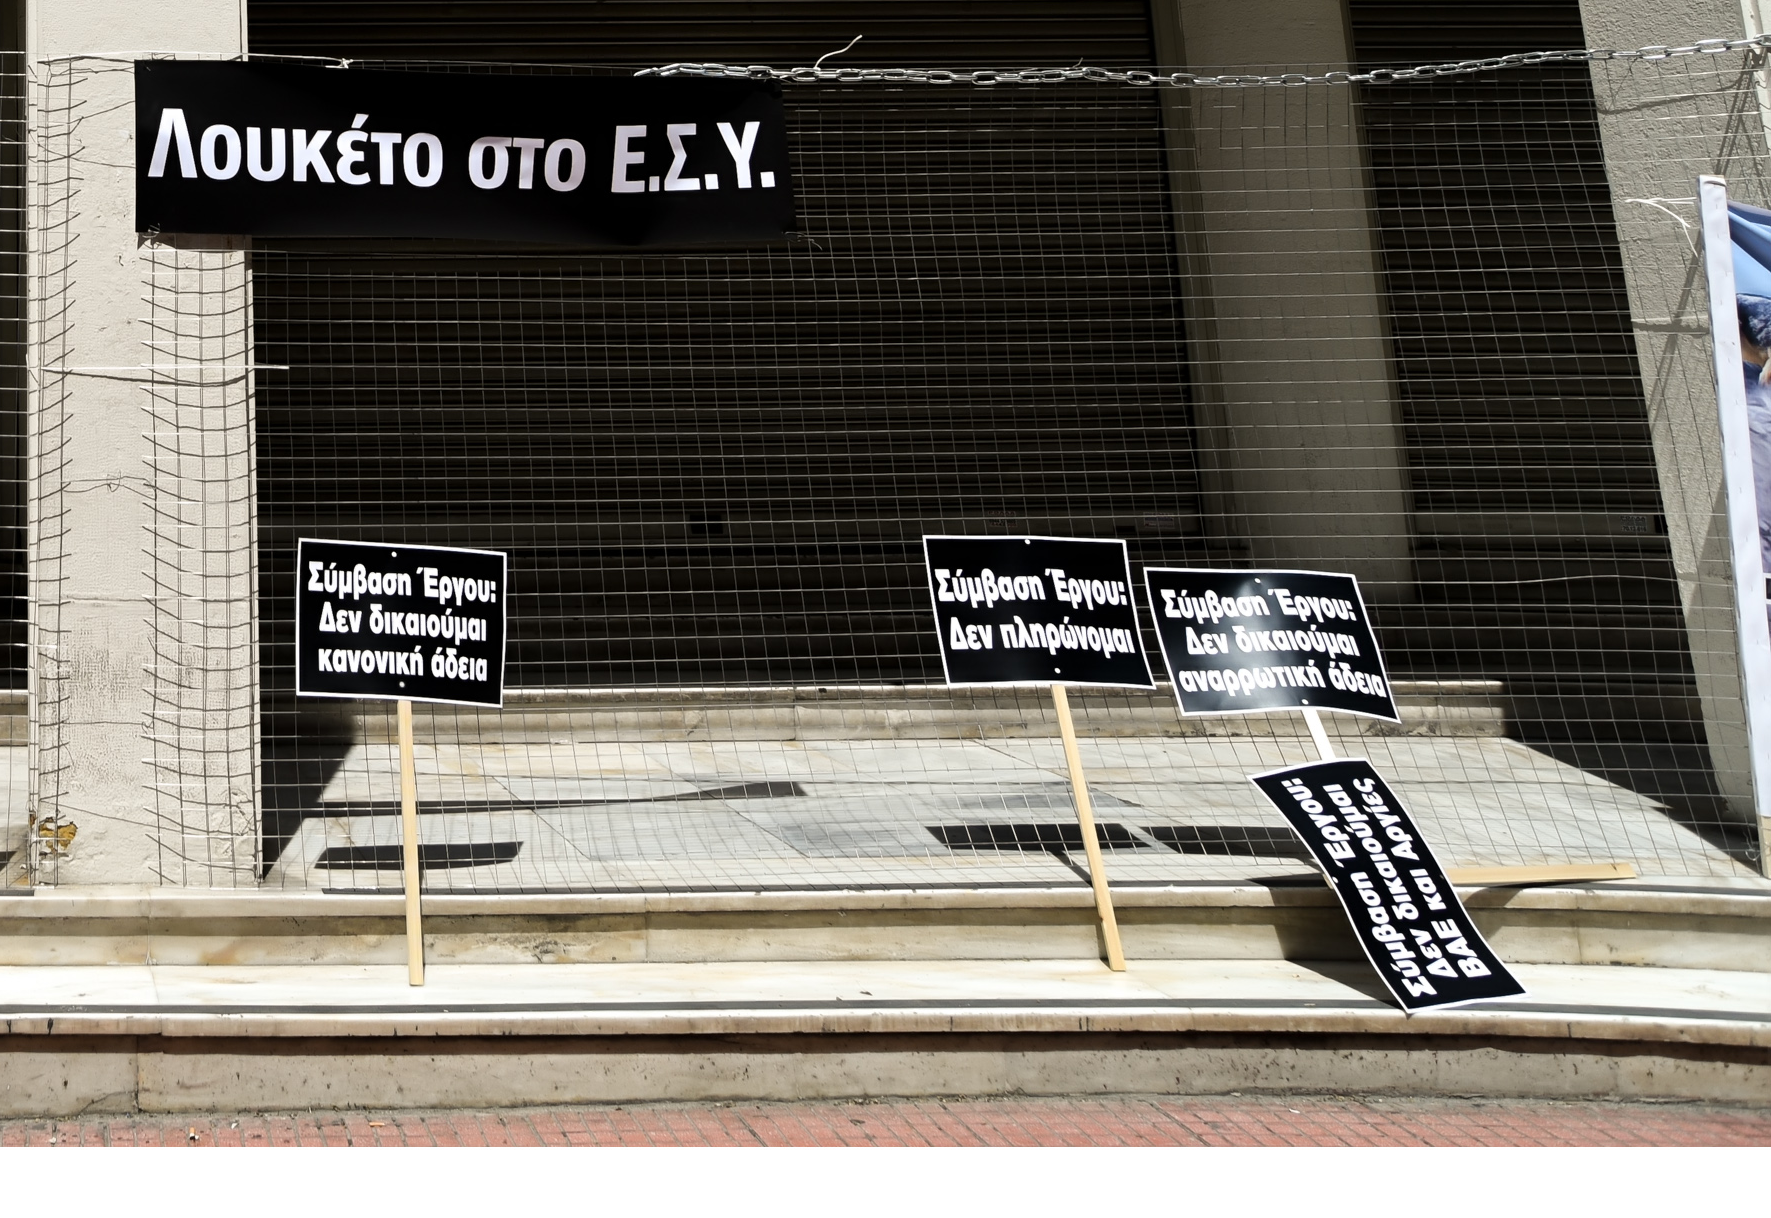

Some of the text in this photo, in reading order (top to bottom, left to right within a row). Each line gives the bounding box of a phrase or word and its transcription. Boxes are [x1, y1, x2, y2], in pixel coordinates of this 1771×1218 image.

[147, 108, 776, 193] Λουκέτο στο Ε.Σ.Υ.
[307, 561, 497, 607] Σύμβαση Έργου:
[934, 567, 1128, 611] Σύμβαση Έργου:
[1160, 588, 1358, 624] Σύμβαση Έργου:
[318, 601, 487, 646] Δεν δικαιούμαι
[950, 615, 1136, 659] Δεν πληρώνομαι
[1185, 624, 1361, 660] Δεν δικαιούμαι
[318, 645, 488, 682] κανονική άδεια
[1178, 659, 1388, 699] αναρρωτική άδεια
[1280, 777, 1438, 998] Σύμβαση Έργου:
[1322, 783, 1459, 979] Δεν δικαιούμαι
[1352, 777, 1492, 979] ΒΑΕ και Αργίες
